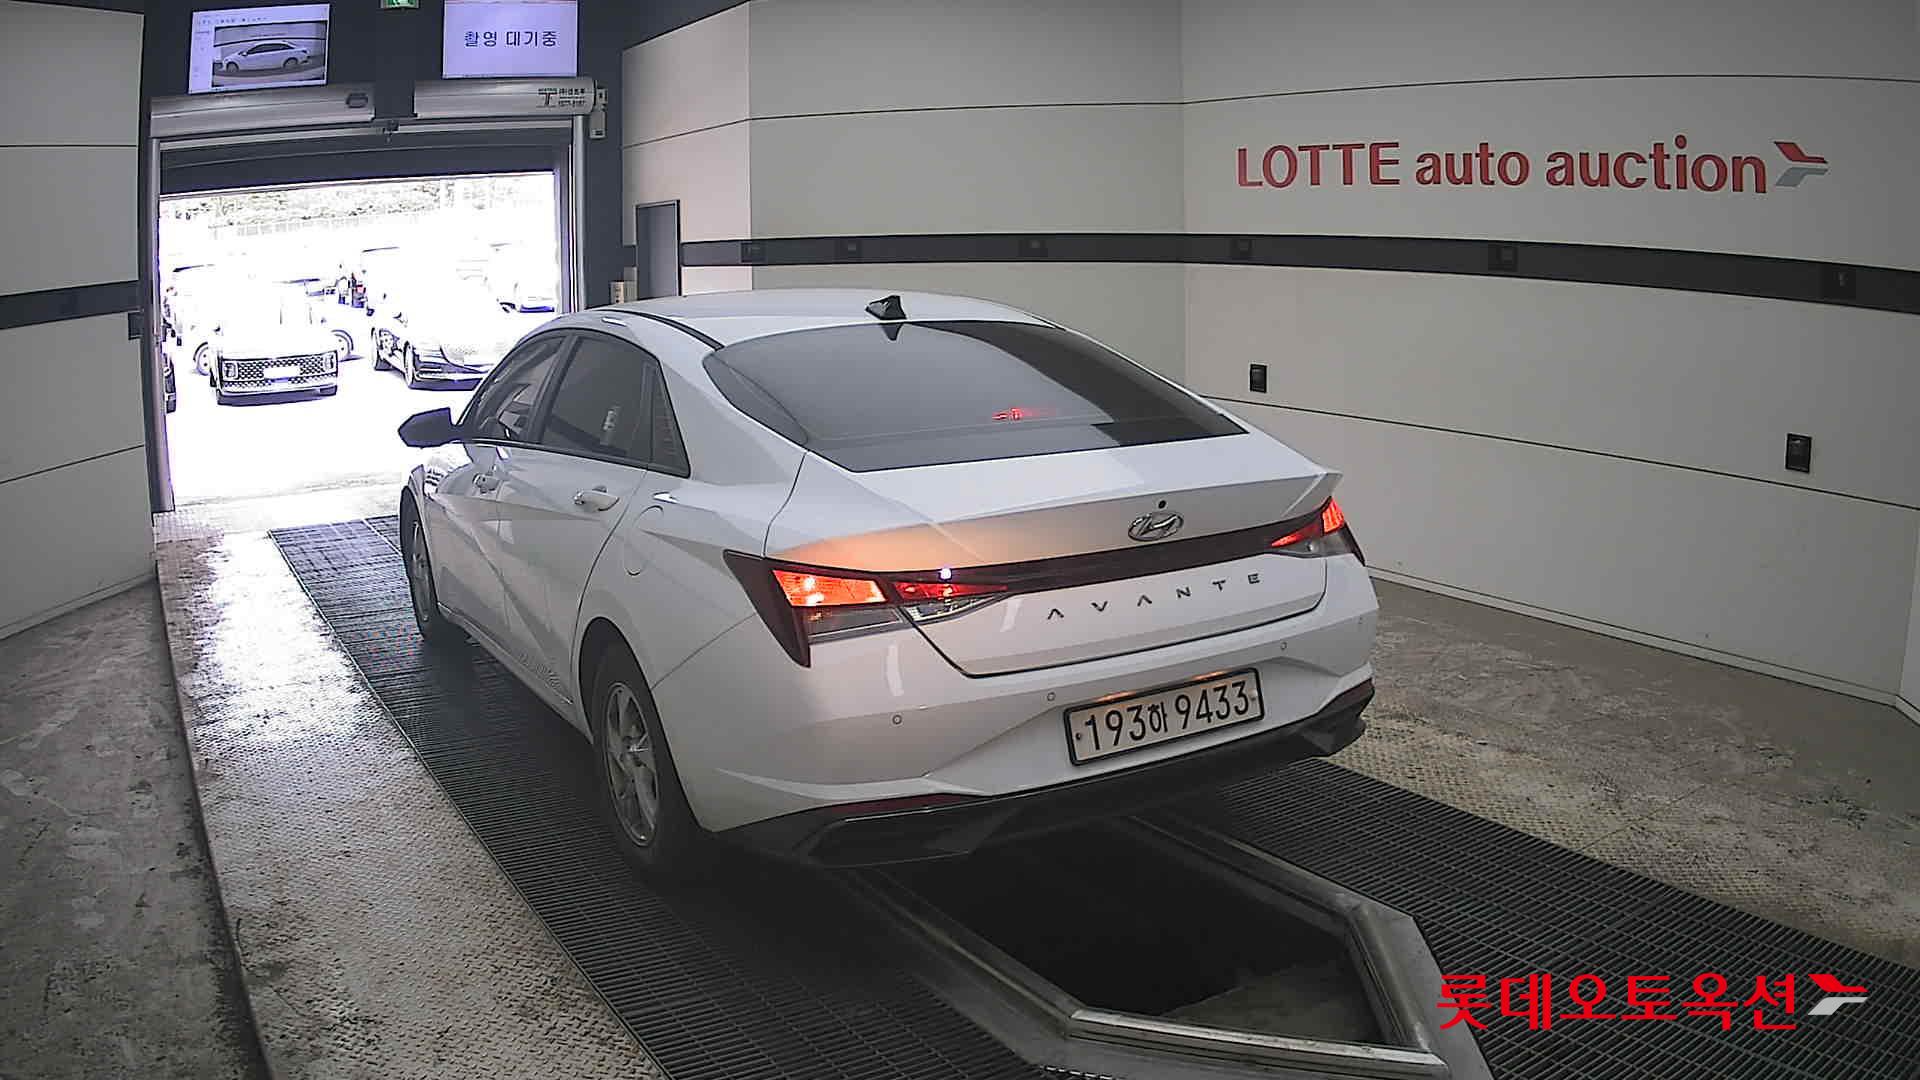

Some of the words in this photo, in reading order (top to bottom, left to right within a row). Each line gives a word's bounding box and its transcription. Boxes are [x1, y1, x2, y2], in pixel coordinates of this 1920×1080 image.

[464, 30, 498, 48] 촬영
[505, 30, 558, 48] 대기중
[1237, 142, 1400, 188] LOTTE
[1415, 142, 1530, 187] auto
[1544, 135, 1767, 194] auction
[1047, 573, 1261, 621] AVANTE
[1084, 701, 1169, 751] 193하
[1174, 680, 1251, 731] 9433
